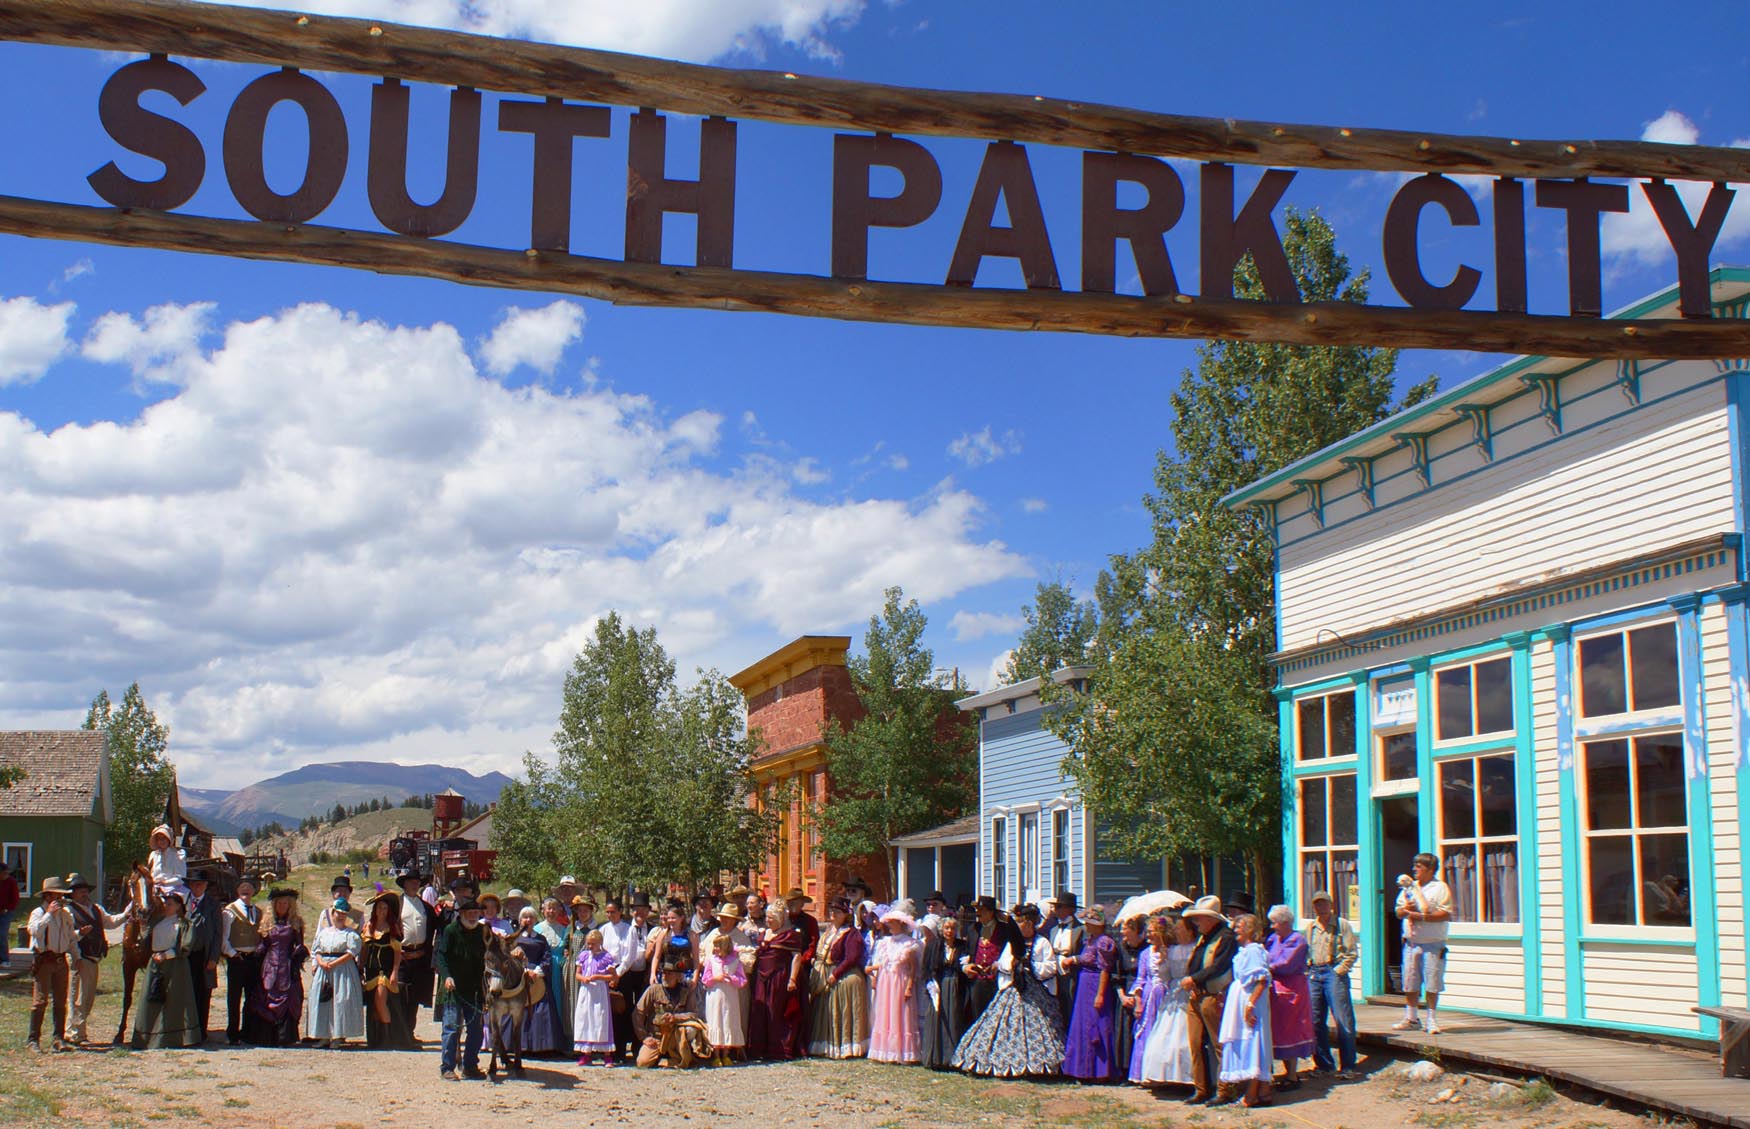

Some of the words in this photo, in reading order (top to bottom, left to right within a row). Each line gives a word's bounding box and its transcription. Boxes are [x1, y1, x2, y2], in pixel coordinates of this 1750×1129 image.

[87, 58, 738, 268] SOUTH
[832, 133, 1301, 302] PARK
[1384, 173, 1737, 319] CITY
